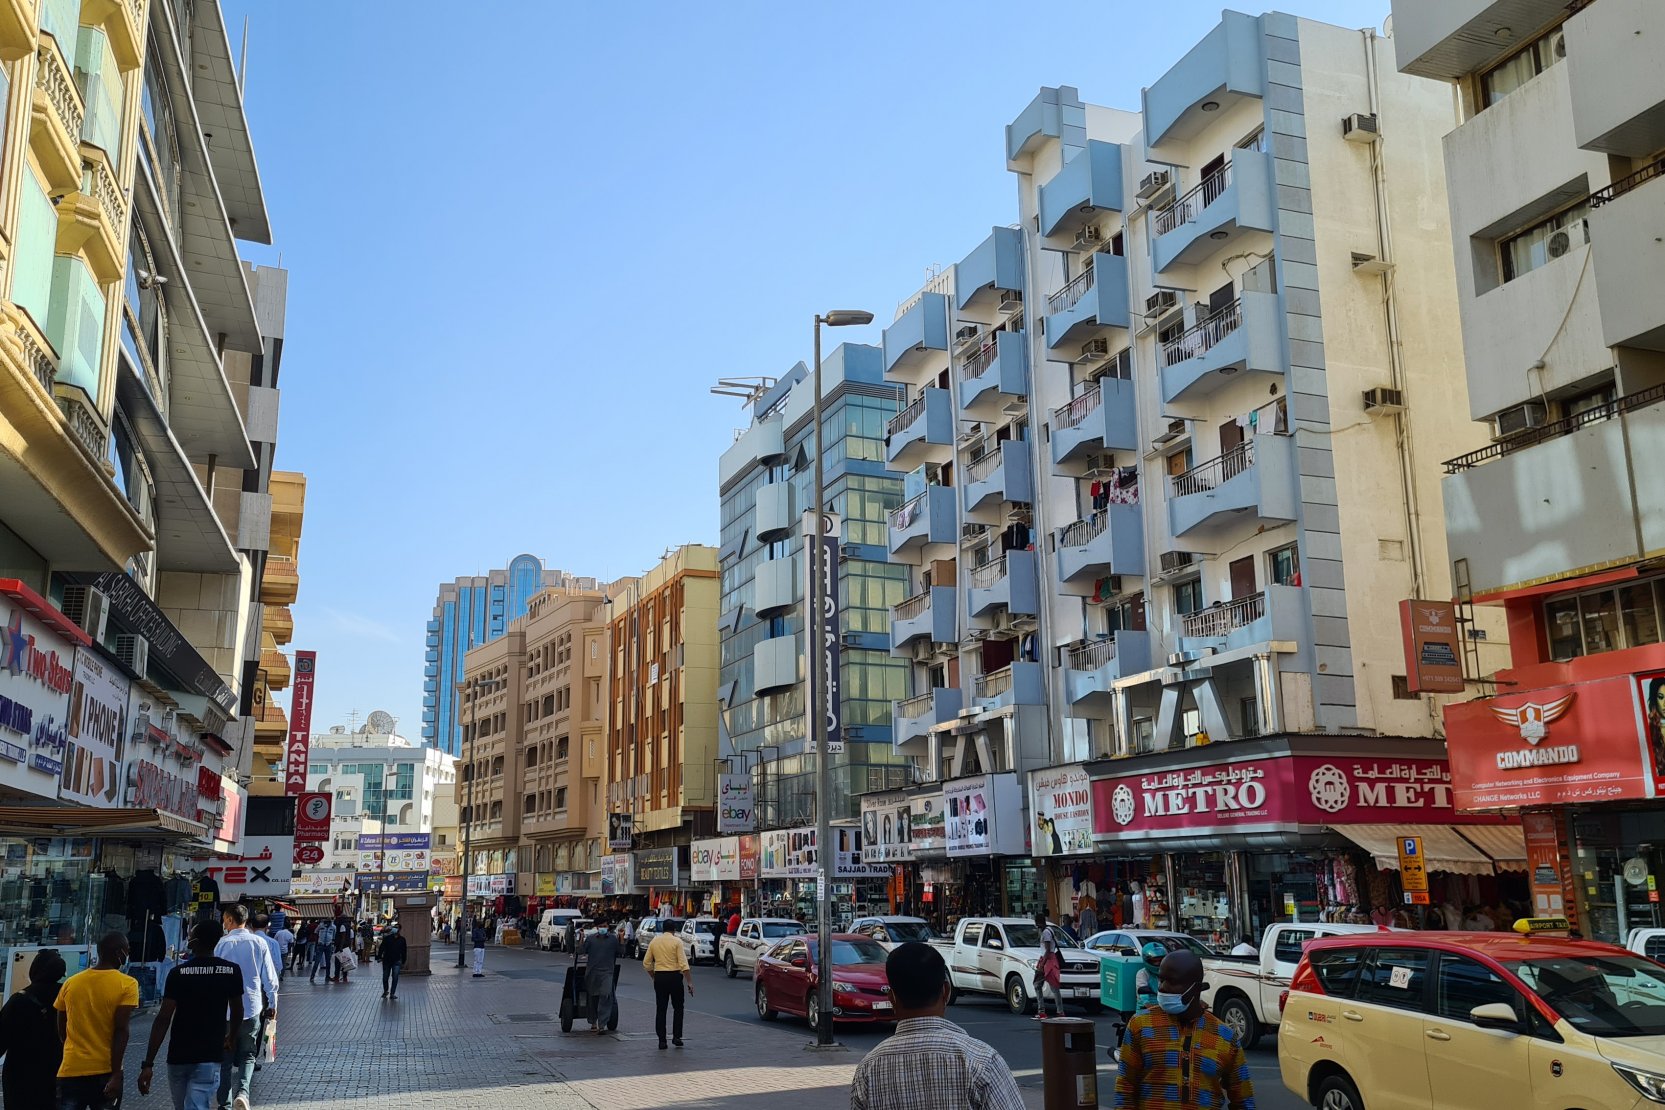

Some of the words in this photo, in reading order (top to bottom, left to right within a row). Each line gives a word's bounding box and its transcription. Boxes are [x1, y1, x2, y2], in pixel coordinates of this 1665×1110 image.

[26, 634, 47, 681] Two
[48, 650, 72, 694] Stars
[87, 696, 117, 748] PHONE
[1497, 745, 1578, 769] COMMANDO
[1141, 774, 1173, 790] العامة
[1173, 770, 1202, 790] للتجارة
[1472, 781, 1495, 789] Computer
[1495, 778, 1523, 788] Networking
[1533, 775, 1562, 784] Electronics
[1563, 774, 1593, 782] Equipment
[1593, 771, 1621, 780] Company
[1053, 789, 1089, 809] MONDO
[1142, 781, 1266, 817] METRO
[1473, 794, 1498, 802] CHANGE
[1499, 792, 1527, 801] Networks
[1528, 791, 1541, 799] LLC
[722, 805, 751, 822] ebay
[297, 831, 329, 839] Pharmacy
[302, 850, 319, 859] 24
[1405, 840, 1414, 854] P
[693, 845, 713, 868] ebay
[215, 966, 233, 974] ZEBRA
